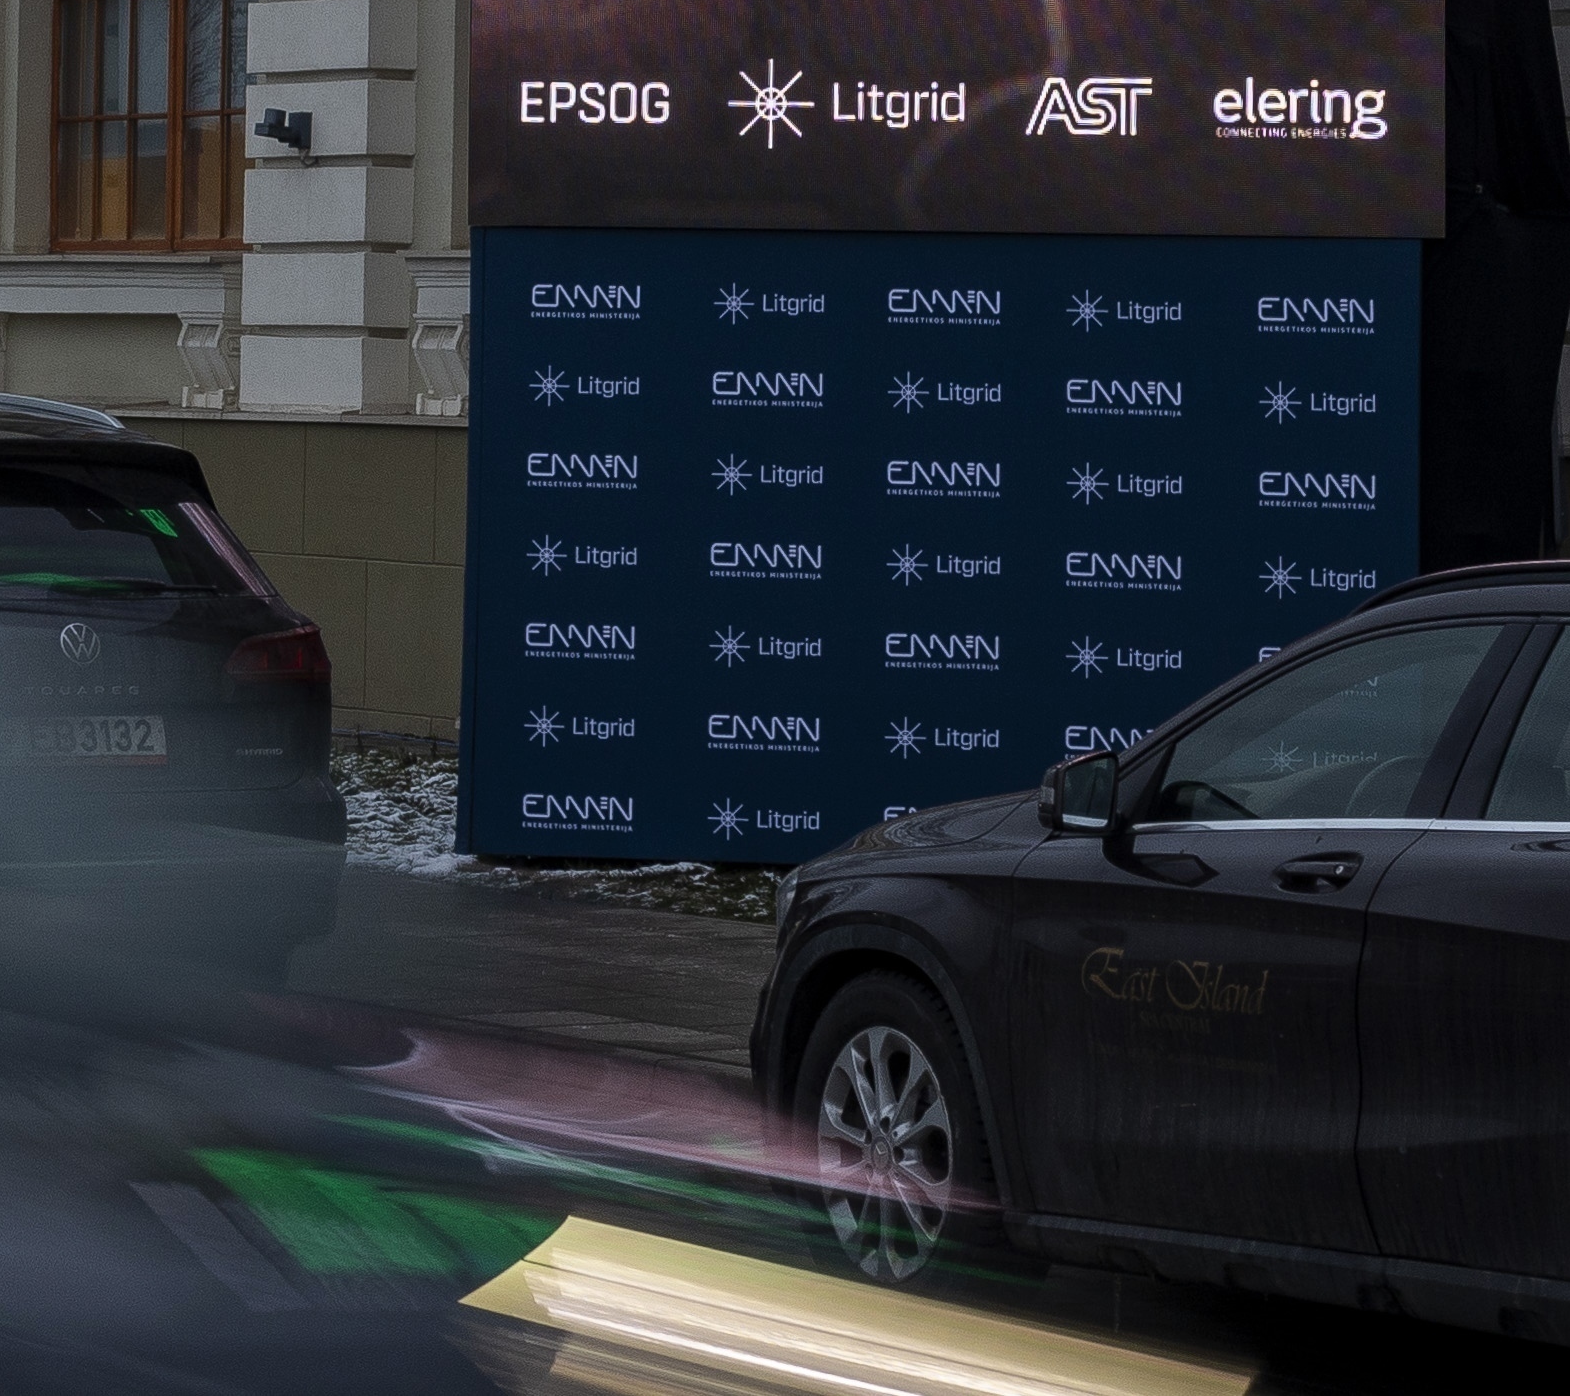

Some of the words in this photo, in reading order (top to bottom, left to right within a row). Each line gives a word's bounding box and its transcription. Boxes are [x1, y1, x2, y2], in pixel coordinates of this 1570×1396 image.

[521, 82, 669, 123] EPSOG
[834, 82, 965, 128] Litgrid
[1026, 77, 1152, 135] AST
[1214, 77, 1387, 139] elering
[1216, 127, 1287, 139] CONNECTING
[531, 311, 585, 319] ENERGETIKOS
[590, 312, 640, 320] MINISTERIJA
[763, 294, 824, 316] Litgrid
[1117, 301, 1181, 323] Litgrid
[888, 316, 944, 325] ENERGETIKOS
[948, 317, 1000, 326] MINISTERIJA
[1258, 324, 1316, 334] ENERGETIKOS
[1321, 324, 1374, 335] MINISTERIJA
[578, 376, 639, 398] Litgrid
[938, 383, 1001, 405] Litgrid
[712, 398, 767, 407] ENERGETIKOS
[772, 400, 823, 409] MINISTERIJA
[1066, 406, 1124, 416] ENERGETIKOS
[1128, 408, 1181, 418] MINISTERIJA
[1311, 393, 1376, 415] Litgrid
[527, 479, 582, 488] ENERGETIKOS
[586, 481, 637, 490] MINISTERIJA
[761, 465, 823, 487] Litgrid
[1118, 474, 1182, 497] Litgrid
[887, 488, 943, 497] ENERGETIKOS
[948, 490, 1000, 499] MINISTERIJA
[1259, 499, 1317, 509] ENERGETIKOS
[1322, 500, 1375, 511] MINISTERIJA
[575, 546, 637, 568] Litgrid
[937, 555, 1000, 577] Litgrid
[710, 570, 766, 579] ENERGETIKOS
[770, 571, 821, 581] MINISTERIJA
[1066, 579, 1124, 589] ENERGETIKOS
[1128, 581, 1181, 592] MINISTERIJA
[1311, 568, 1376, 591] Litgrid
[525, 650, 580, 659] ENERGETIKOS
[584, 650, 635, 661] MINISTERIJA
[759, 637, 821, 659] Litgrid
[885, 660, 942, 669] ENERGETIKOS
[946, 662, 999, 672] MINISTERIJA
[1117, 648, 1182, 671] Litgrid
[573, 717, 634, 739] Litgrid
[935, 728, 999, 750] Litgrid
[708, 741, 764, 751] ENERGETIKOS
[768, 742, 819, 753] MINISTERIJA
[522, 820, 577, 830] ENERGETIKOS
[581, 822, 632, 833] MINISTERIJA
[757, 810, 820, 832] Litgrid
[1081, 946, 1160, 1003] East
[1165, 959, 1270, 1015] Island
